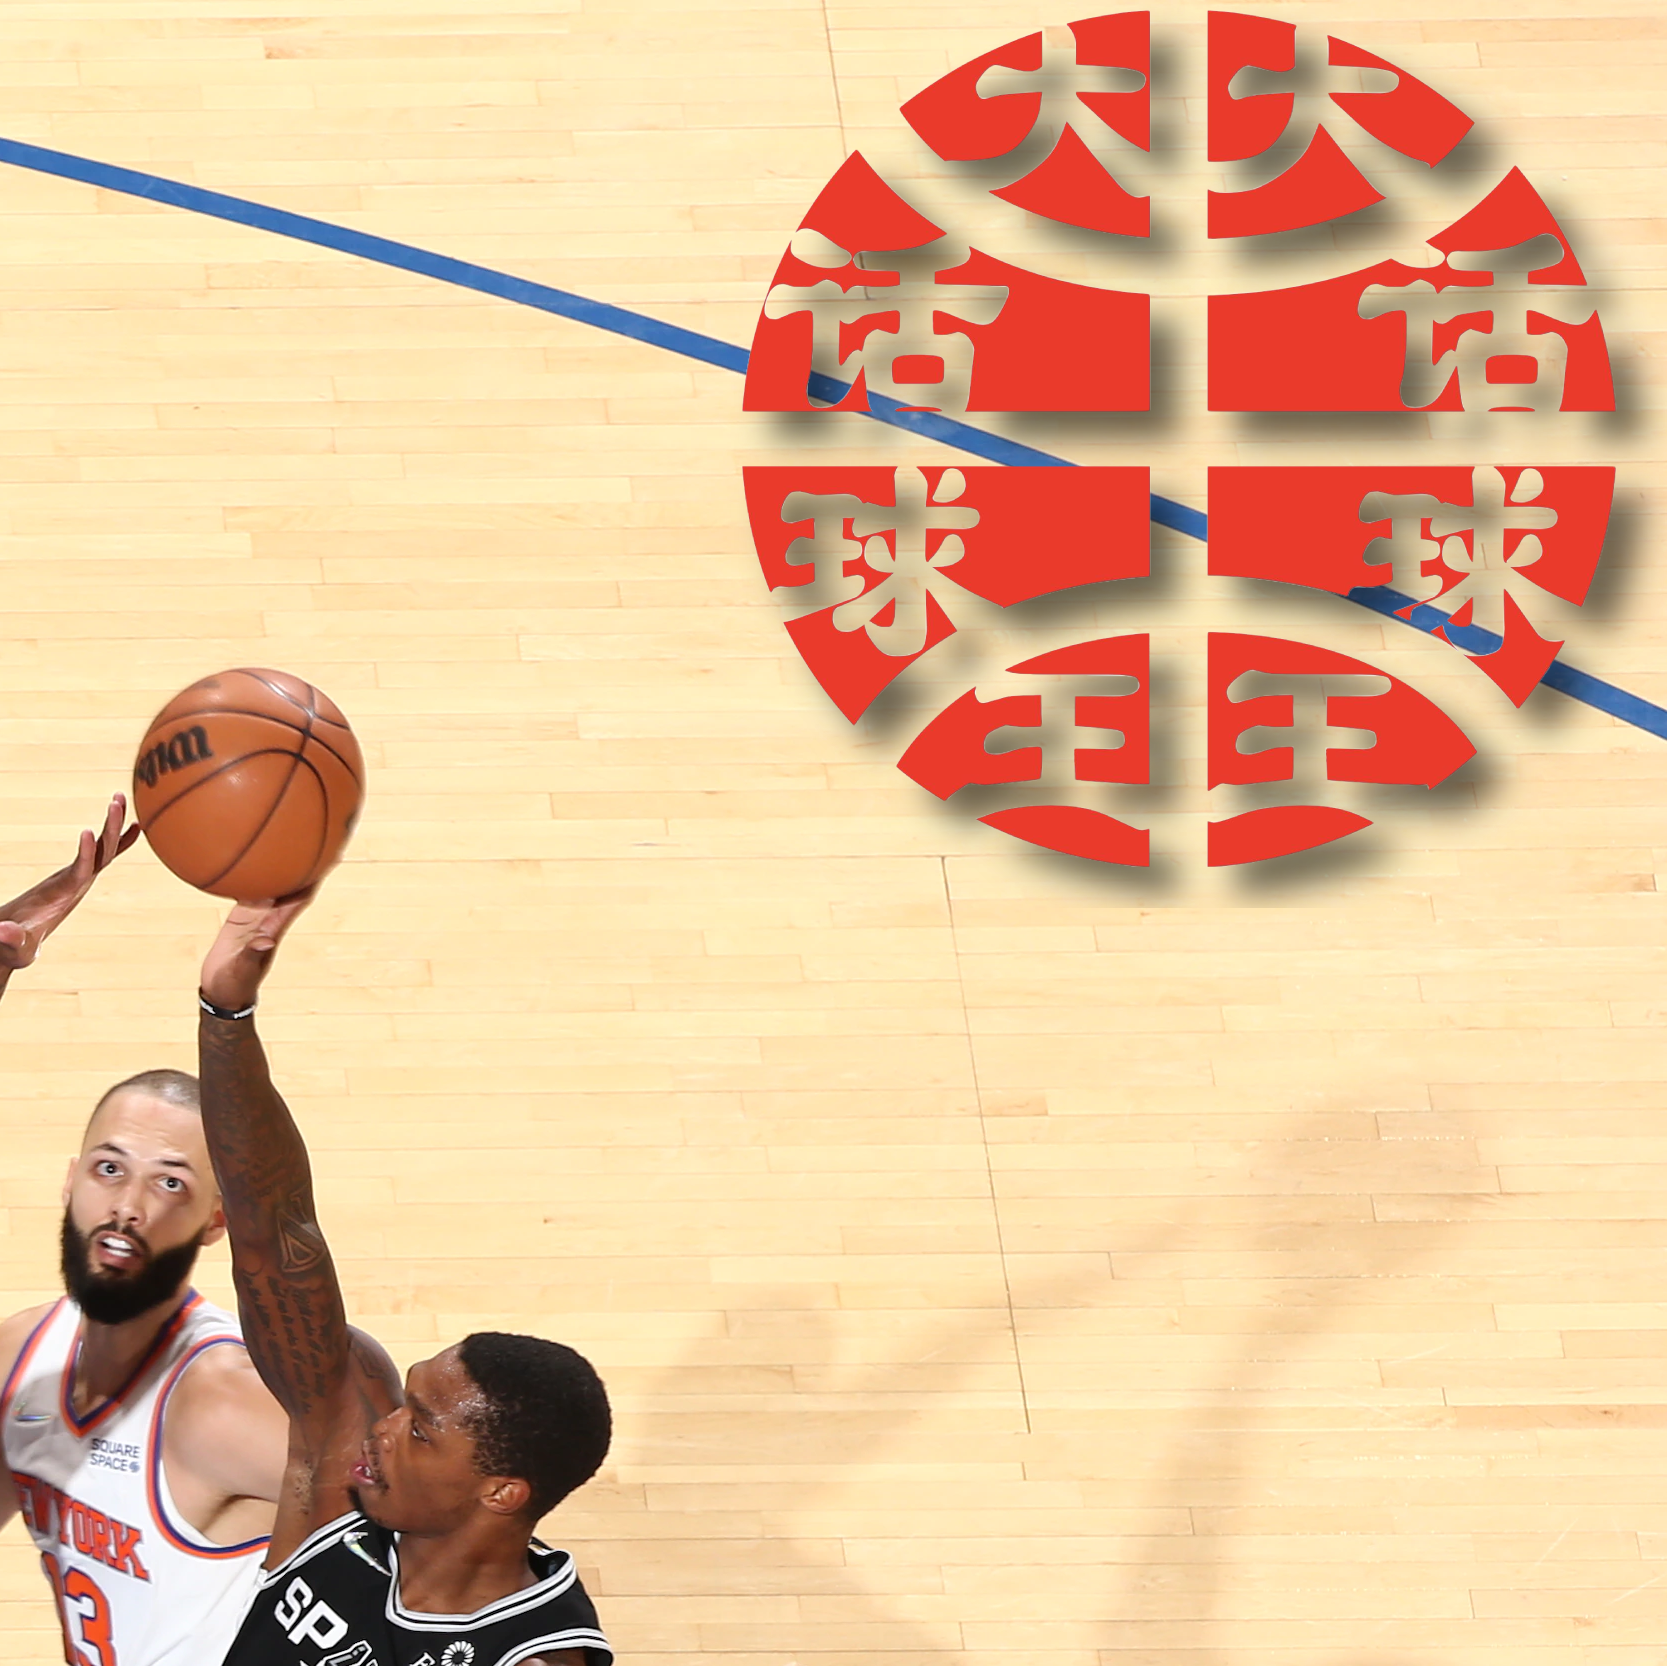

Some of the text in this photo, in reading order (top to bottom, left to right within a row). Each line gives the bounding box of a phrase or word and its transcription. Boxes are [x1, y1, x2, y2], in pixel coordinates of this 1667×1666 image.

[92, 1437, 141, 1458] SQUARE
[90, 1453, 129, 1472] SPACE
[53, 1487, 153, 1584] YORK
